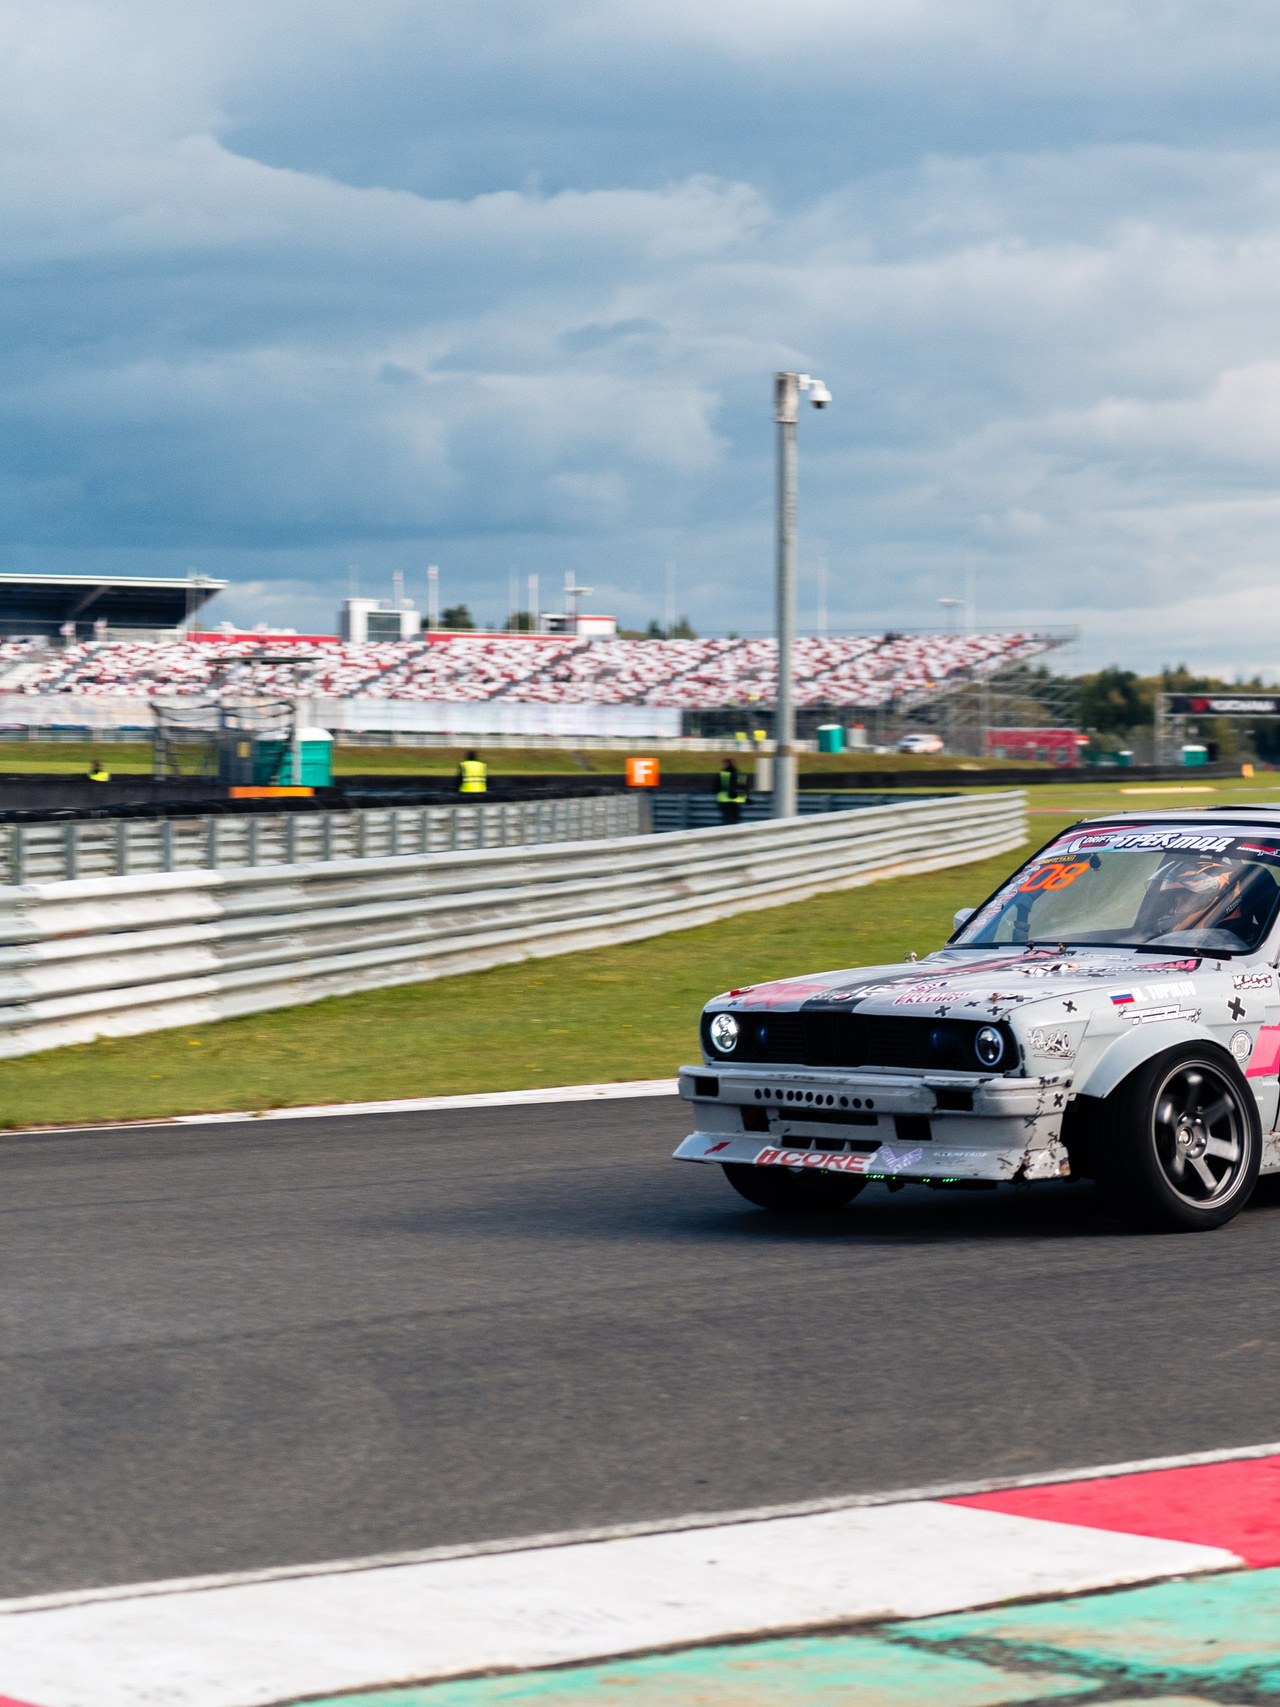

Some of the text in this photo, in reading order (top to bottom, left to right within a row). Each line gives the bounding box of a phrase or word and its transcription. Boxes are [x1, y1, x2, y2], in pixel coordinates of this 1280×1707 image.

[633, 760, 654, 783] F
[1019, 862, 1091, 892] 08
[1145, 981, 1197, 1000] TUPIKOV
